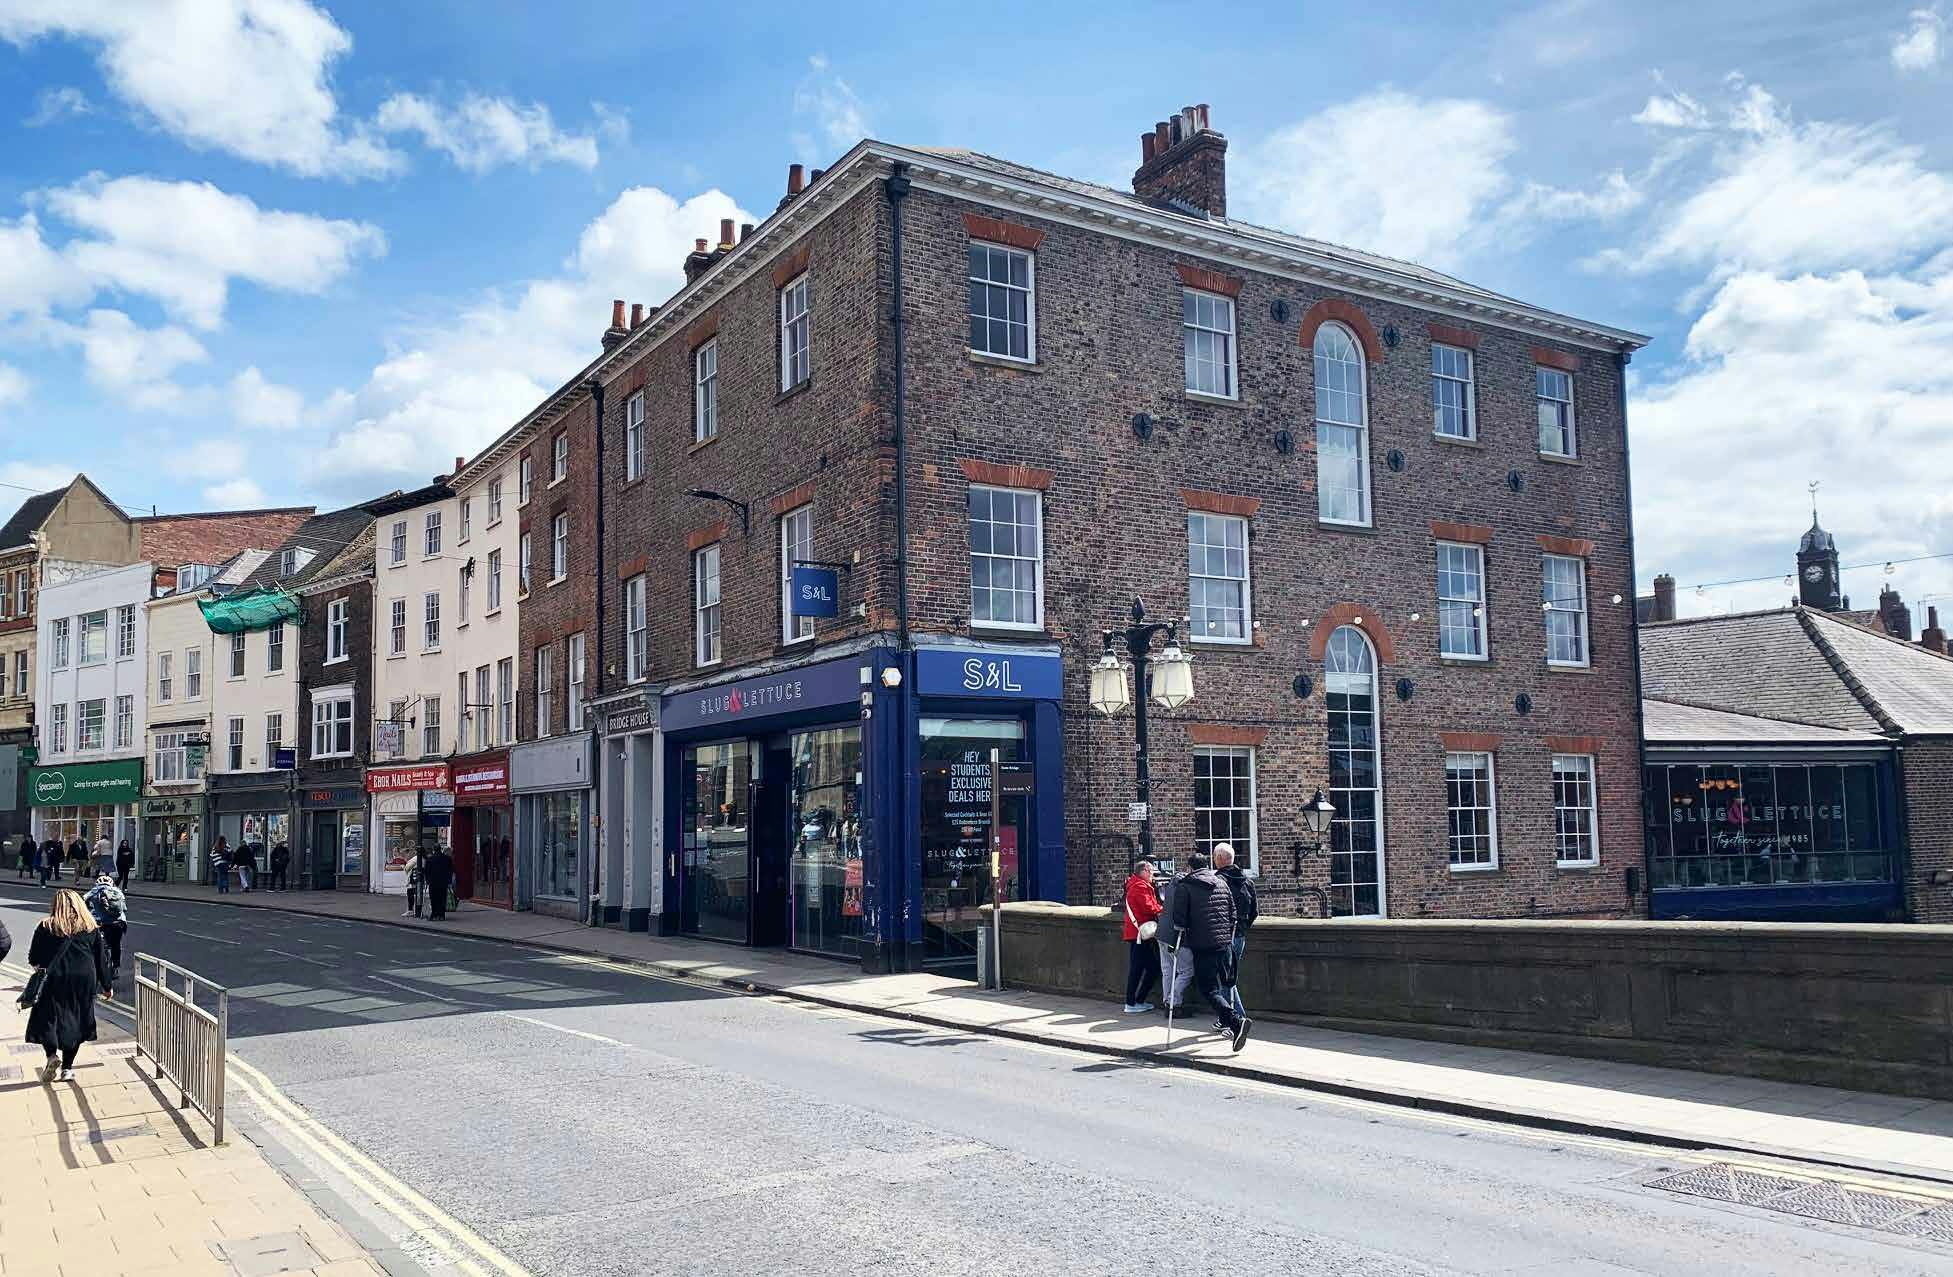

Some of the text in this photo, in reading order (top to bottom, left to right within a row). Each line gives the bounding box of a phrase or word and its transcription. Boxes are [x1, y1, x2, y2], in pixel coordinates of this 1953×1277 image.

[802, 584, 831, 601] S&L
[963, 658, 1022, 692] S&L
[609, 712, 649, 730] BRIDGE HOUSE
[964, 751, 980, 763] HEY
[951, 764, 992, 777] STUDENTS,
[38, 782, 64, 792] Specsavers
[373, 773, 412, 788] EBOR NAILS
[951, 777, 992, 790] EXCLUSIVE
[948, 790, 992, 802] DEALS HER
